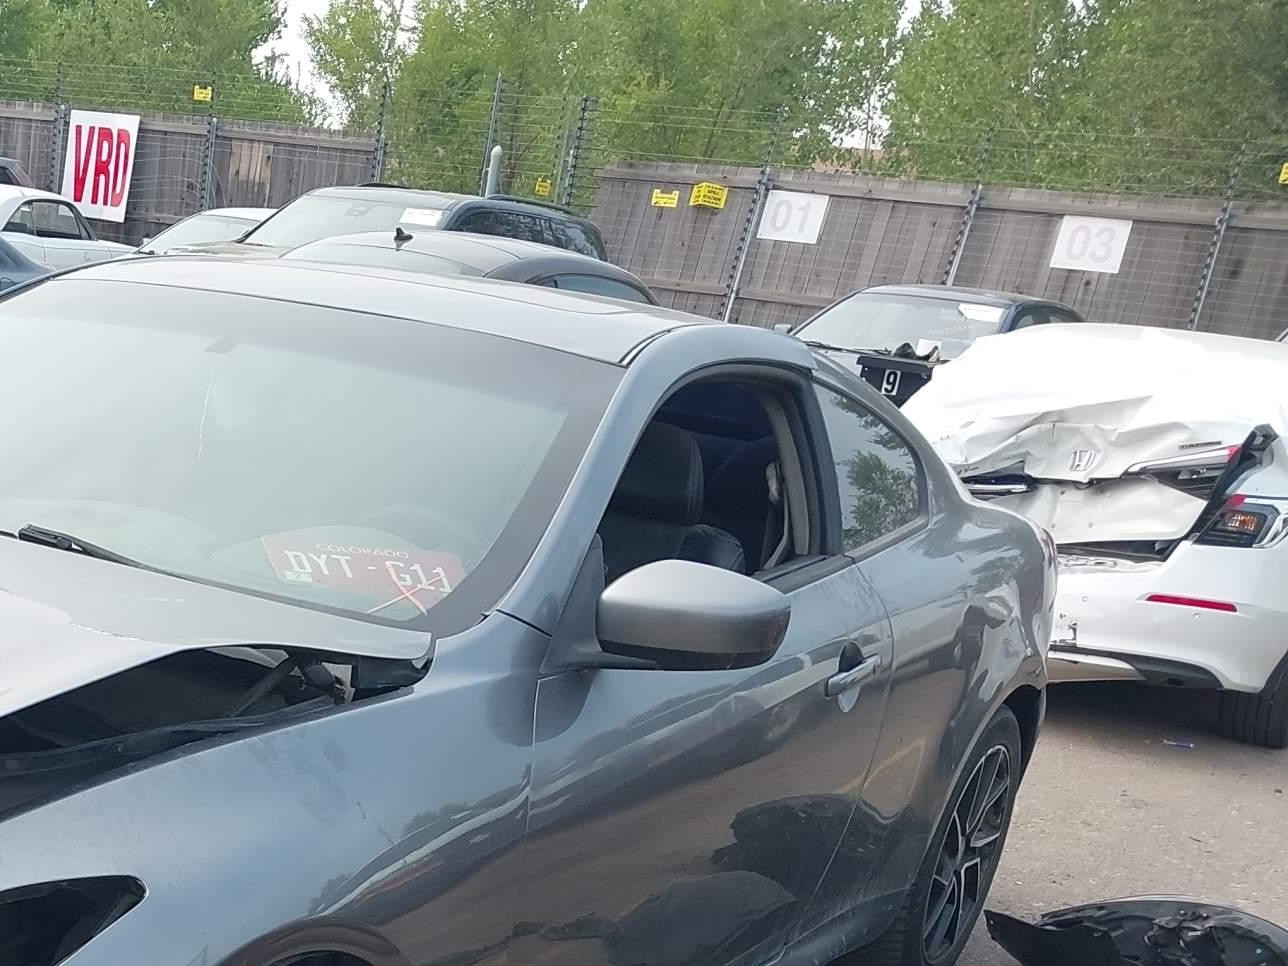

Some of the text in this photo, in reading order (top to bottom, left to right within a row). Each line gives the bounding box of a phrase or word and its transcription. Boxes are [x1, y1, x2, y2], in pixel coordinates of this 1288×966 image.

[73, 125, 130, 207] VRD
[770, 199, 812, 235] 01
[1066, 224, 1116, 263] 03
[883, 370, 899, 394] 9
[315, 543, 410, 559] COLORADO
[283, 550, 353, 578] DYT
[385, 561, 452, 593] G11
